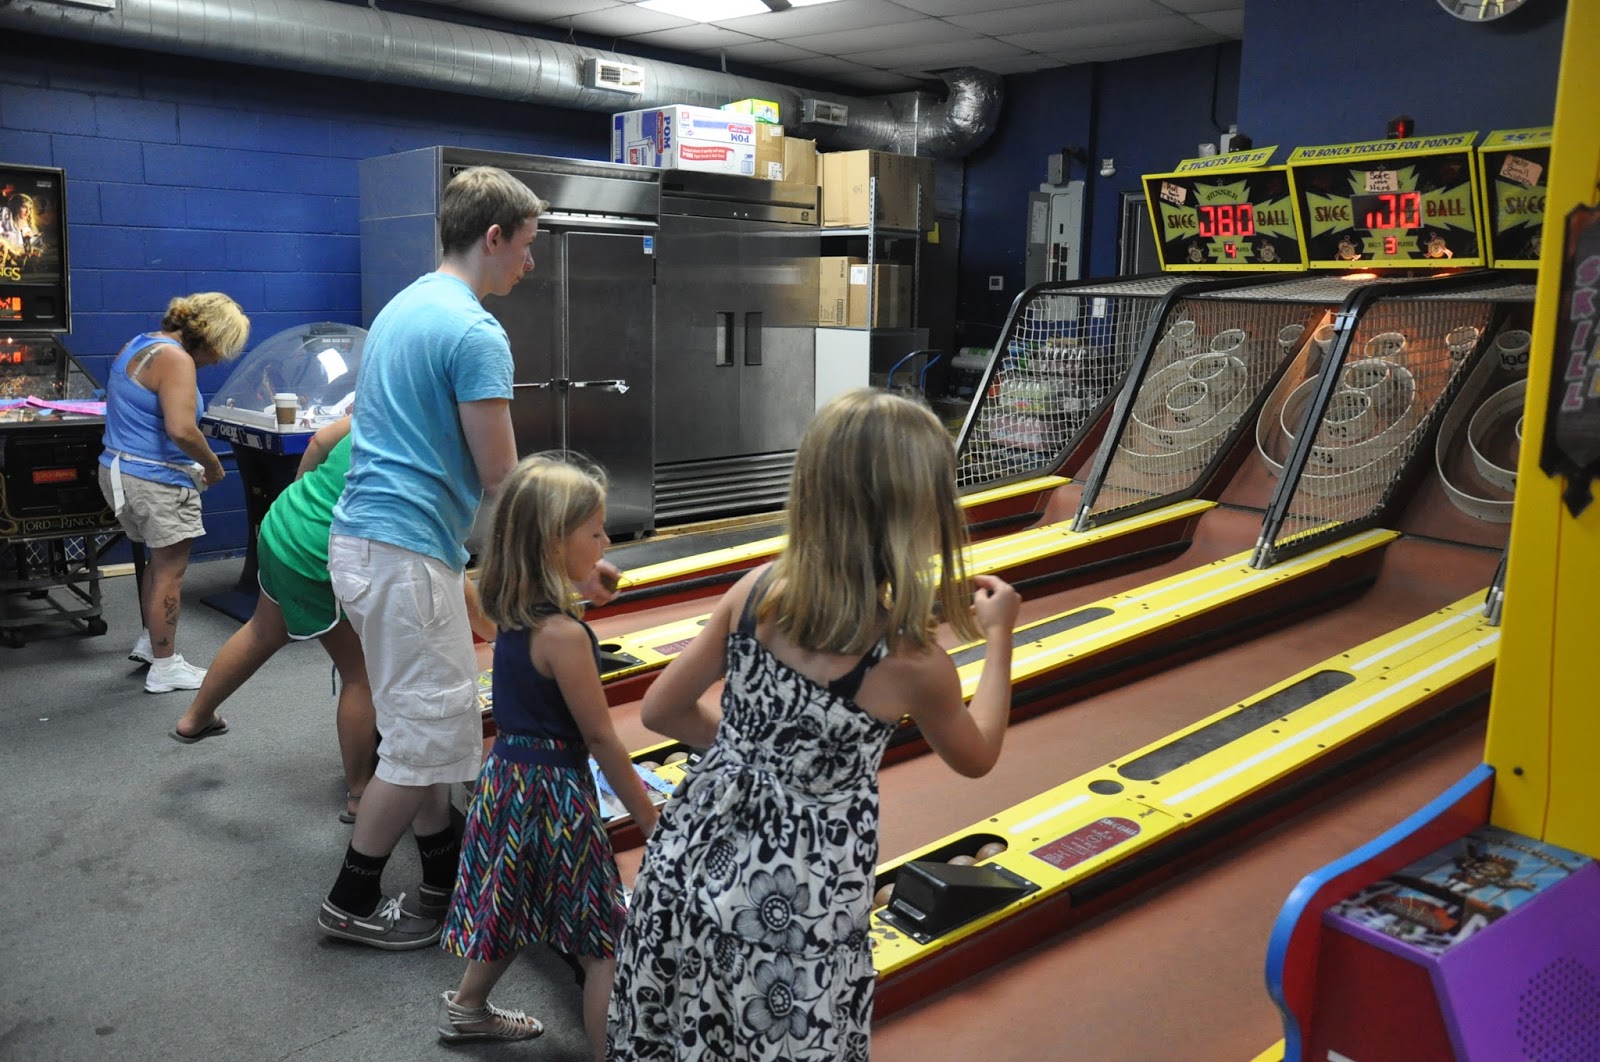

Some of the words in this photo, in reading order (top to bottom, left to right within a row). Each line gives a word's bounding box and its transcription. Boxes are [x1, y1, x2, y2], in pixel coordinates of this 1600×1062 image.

[730, 133, 750, 143] POM
[1300, 149, 1316, 158] NO
[1316, 146, 1352, 157] BONUS
[1352, 142, 1398, 154] TICKETS
[1397, 140, 1420, 150] FOR
[1420, 136, 1465, 149] POINTS
[1188, 157, 1230, 171] TICKETS
[1229, 154, 1251, 165] PER
[1206, 189, 1238, 201] WINNER
[1315, 205, 1350, 223] SKEE
[1426, 198, 1466, 217] BALL
[1167, 213, 1196, 229] SKEE
[1257, 210, 1289, 227] BALL
[1225, 243, 1236, 259] 4
[1385, 236, 1397, 254] 3
[1562, 255, 1600, 411] SKILL
[1501, 353, 1529, 367] 100
[23, 520, 51, 535] LORD
[61, 516, 96, 528] RINGS
